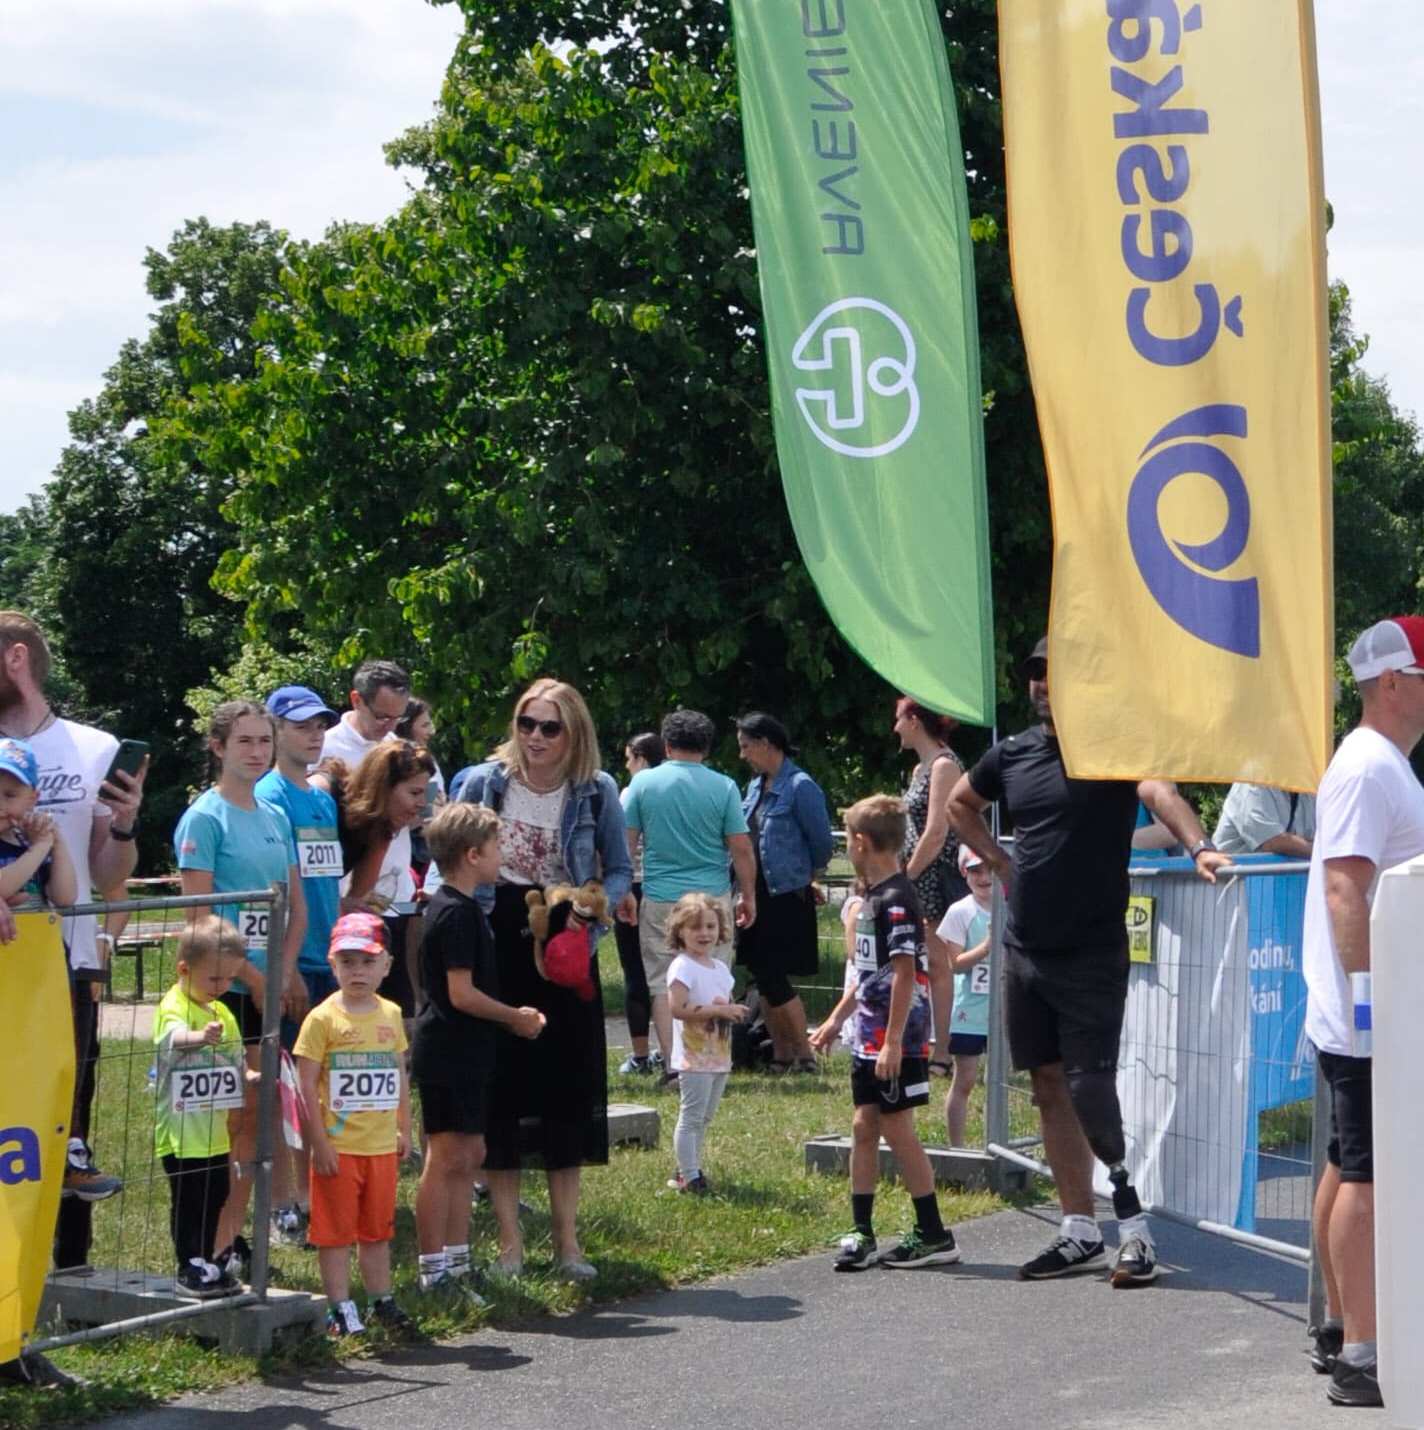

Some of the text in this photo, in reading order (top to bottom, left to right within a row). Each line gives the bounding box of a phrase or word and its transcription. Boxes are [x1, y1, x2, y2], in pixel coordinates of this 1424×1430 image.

[305, 844, 337, 864] 2011
[245, 914, 269, 936] 20
[856, 937, 870, 958] 40
[1250, 938, 1294, 970] odinu,
[180, 1070, 236, 1098] 2079
[339, 1073, 396, 1097] 2076
